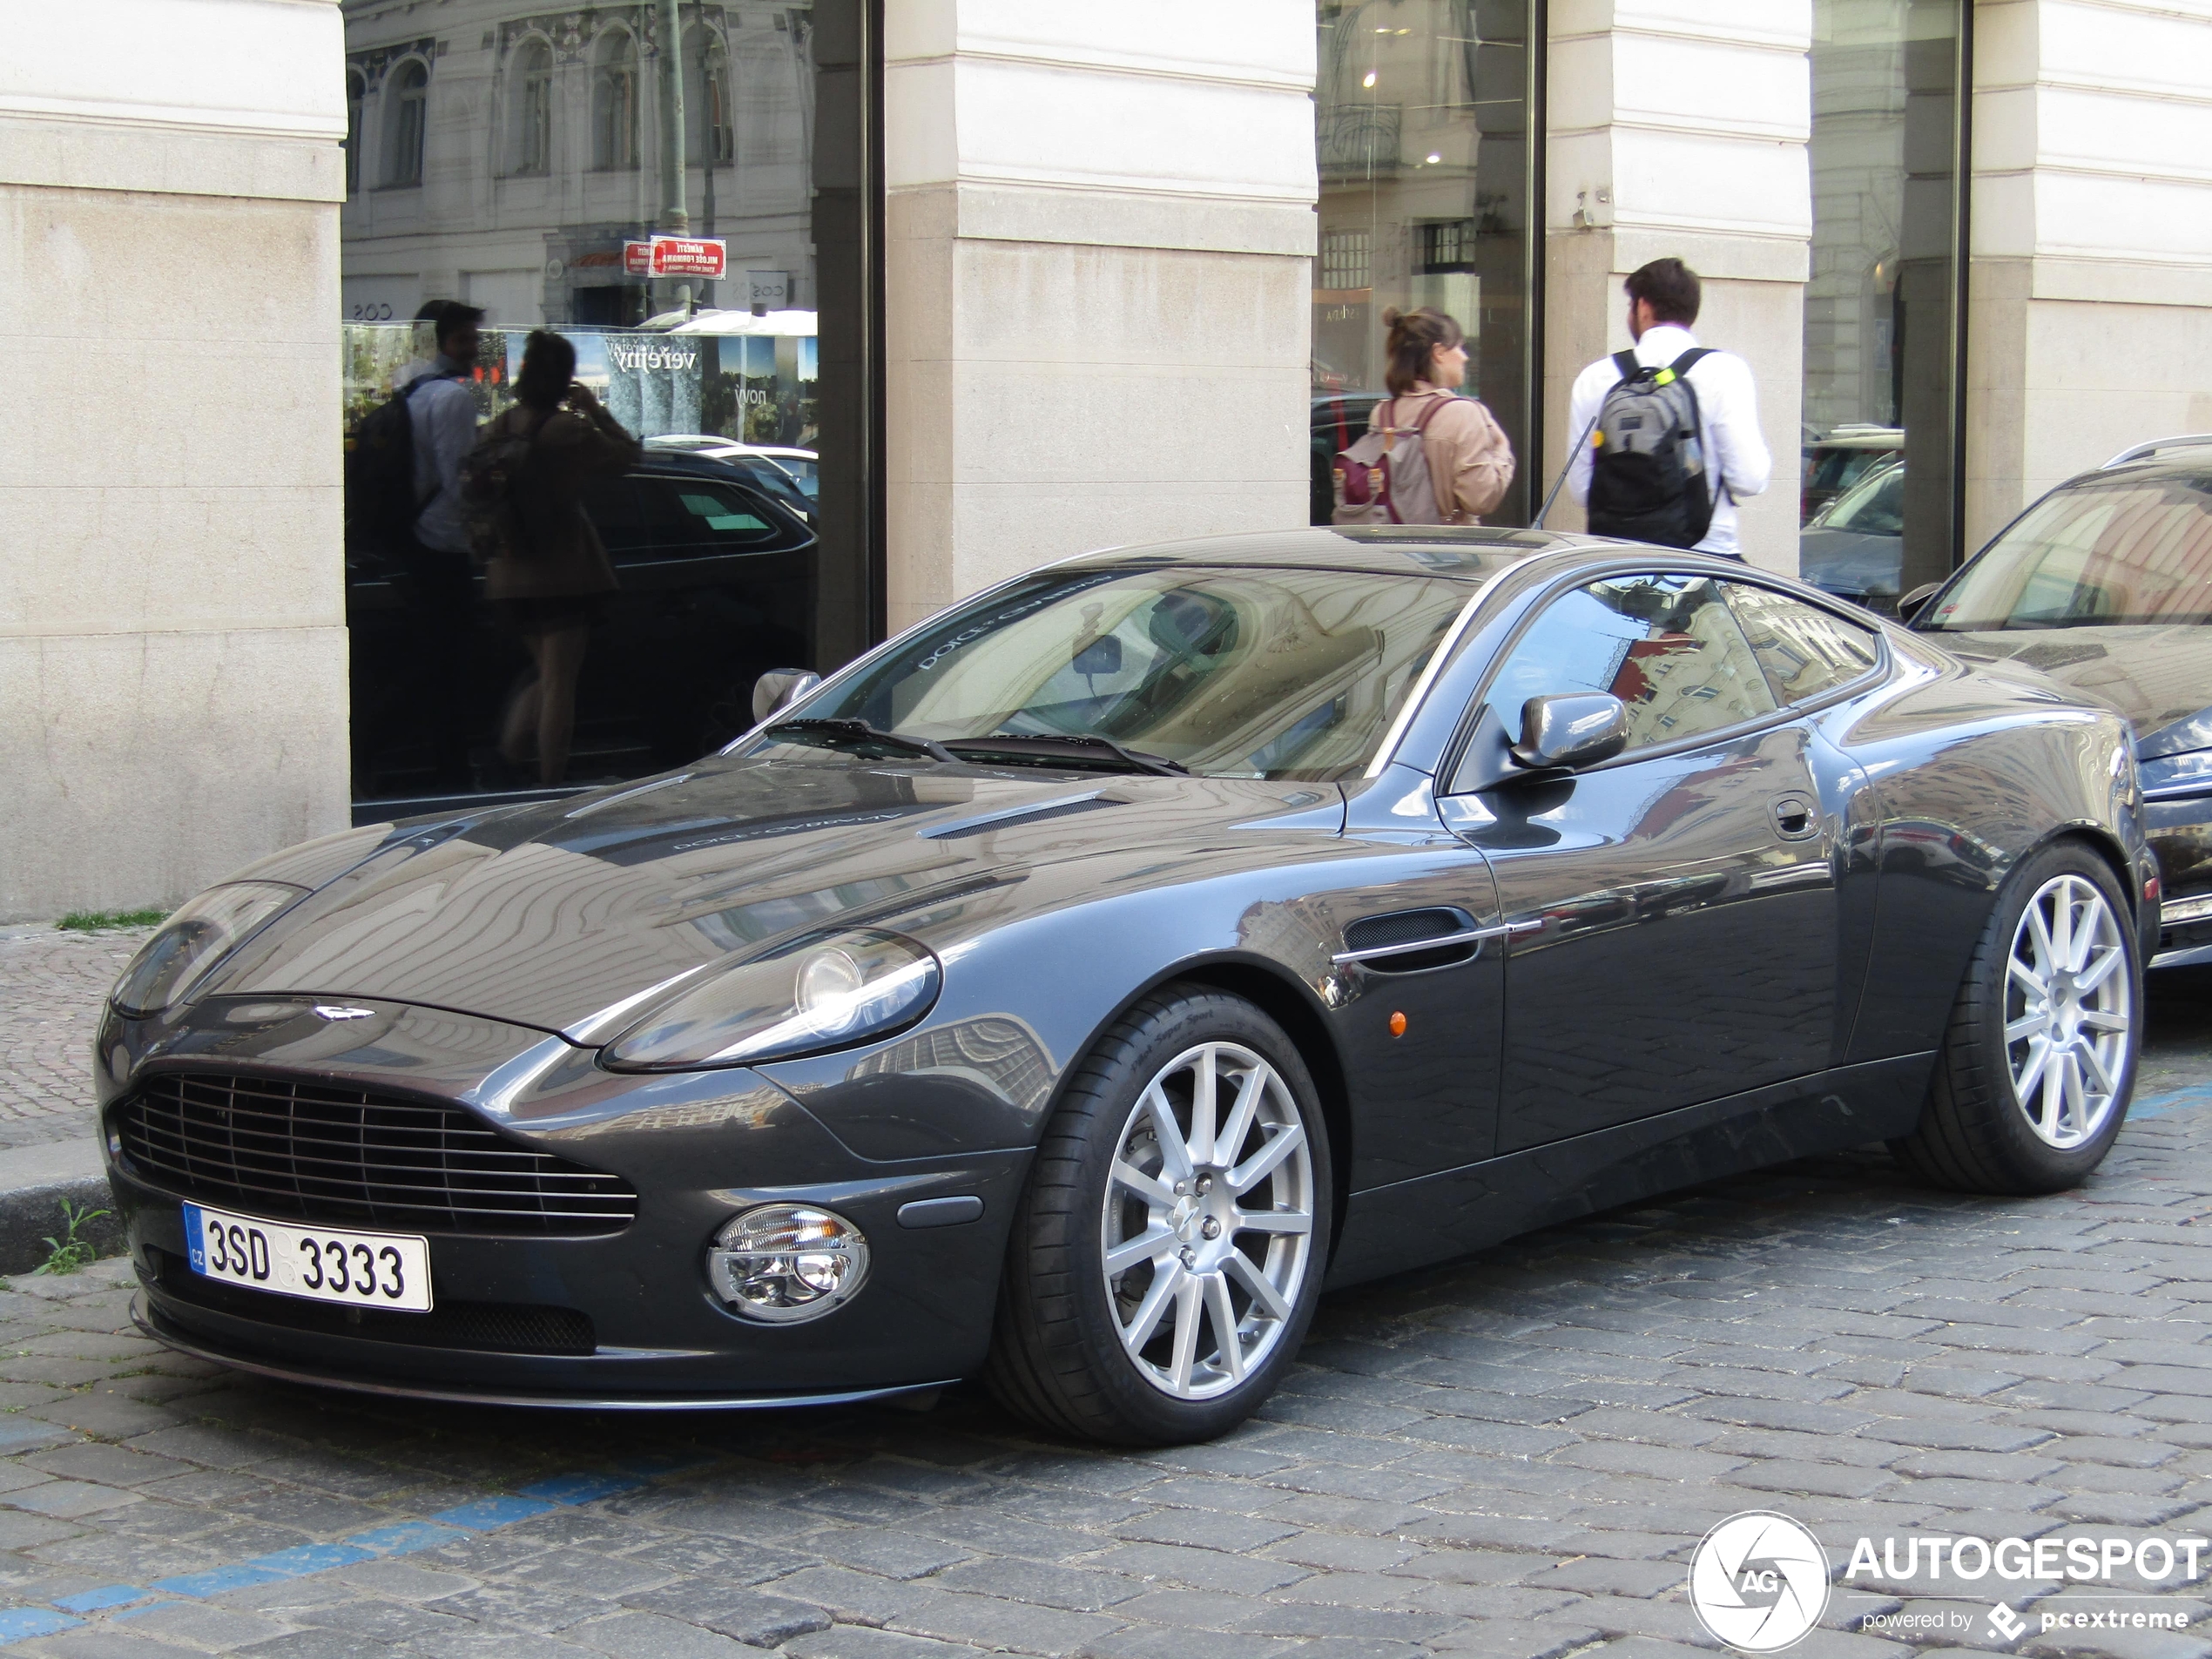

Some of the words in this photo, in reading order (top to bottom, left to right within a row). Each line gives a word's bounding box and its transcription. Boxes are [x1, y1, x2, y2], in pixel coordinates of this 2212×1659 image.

[1185, 1009, 1214, 1025] Sport
[192, 1248, 204, 1265] CZ
[209, 1220, 271, 1280] 3SD
[300, 1238, 405, 1298] 3333
